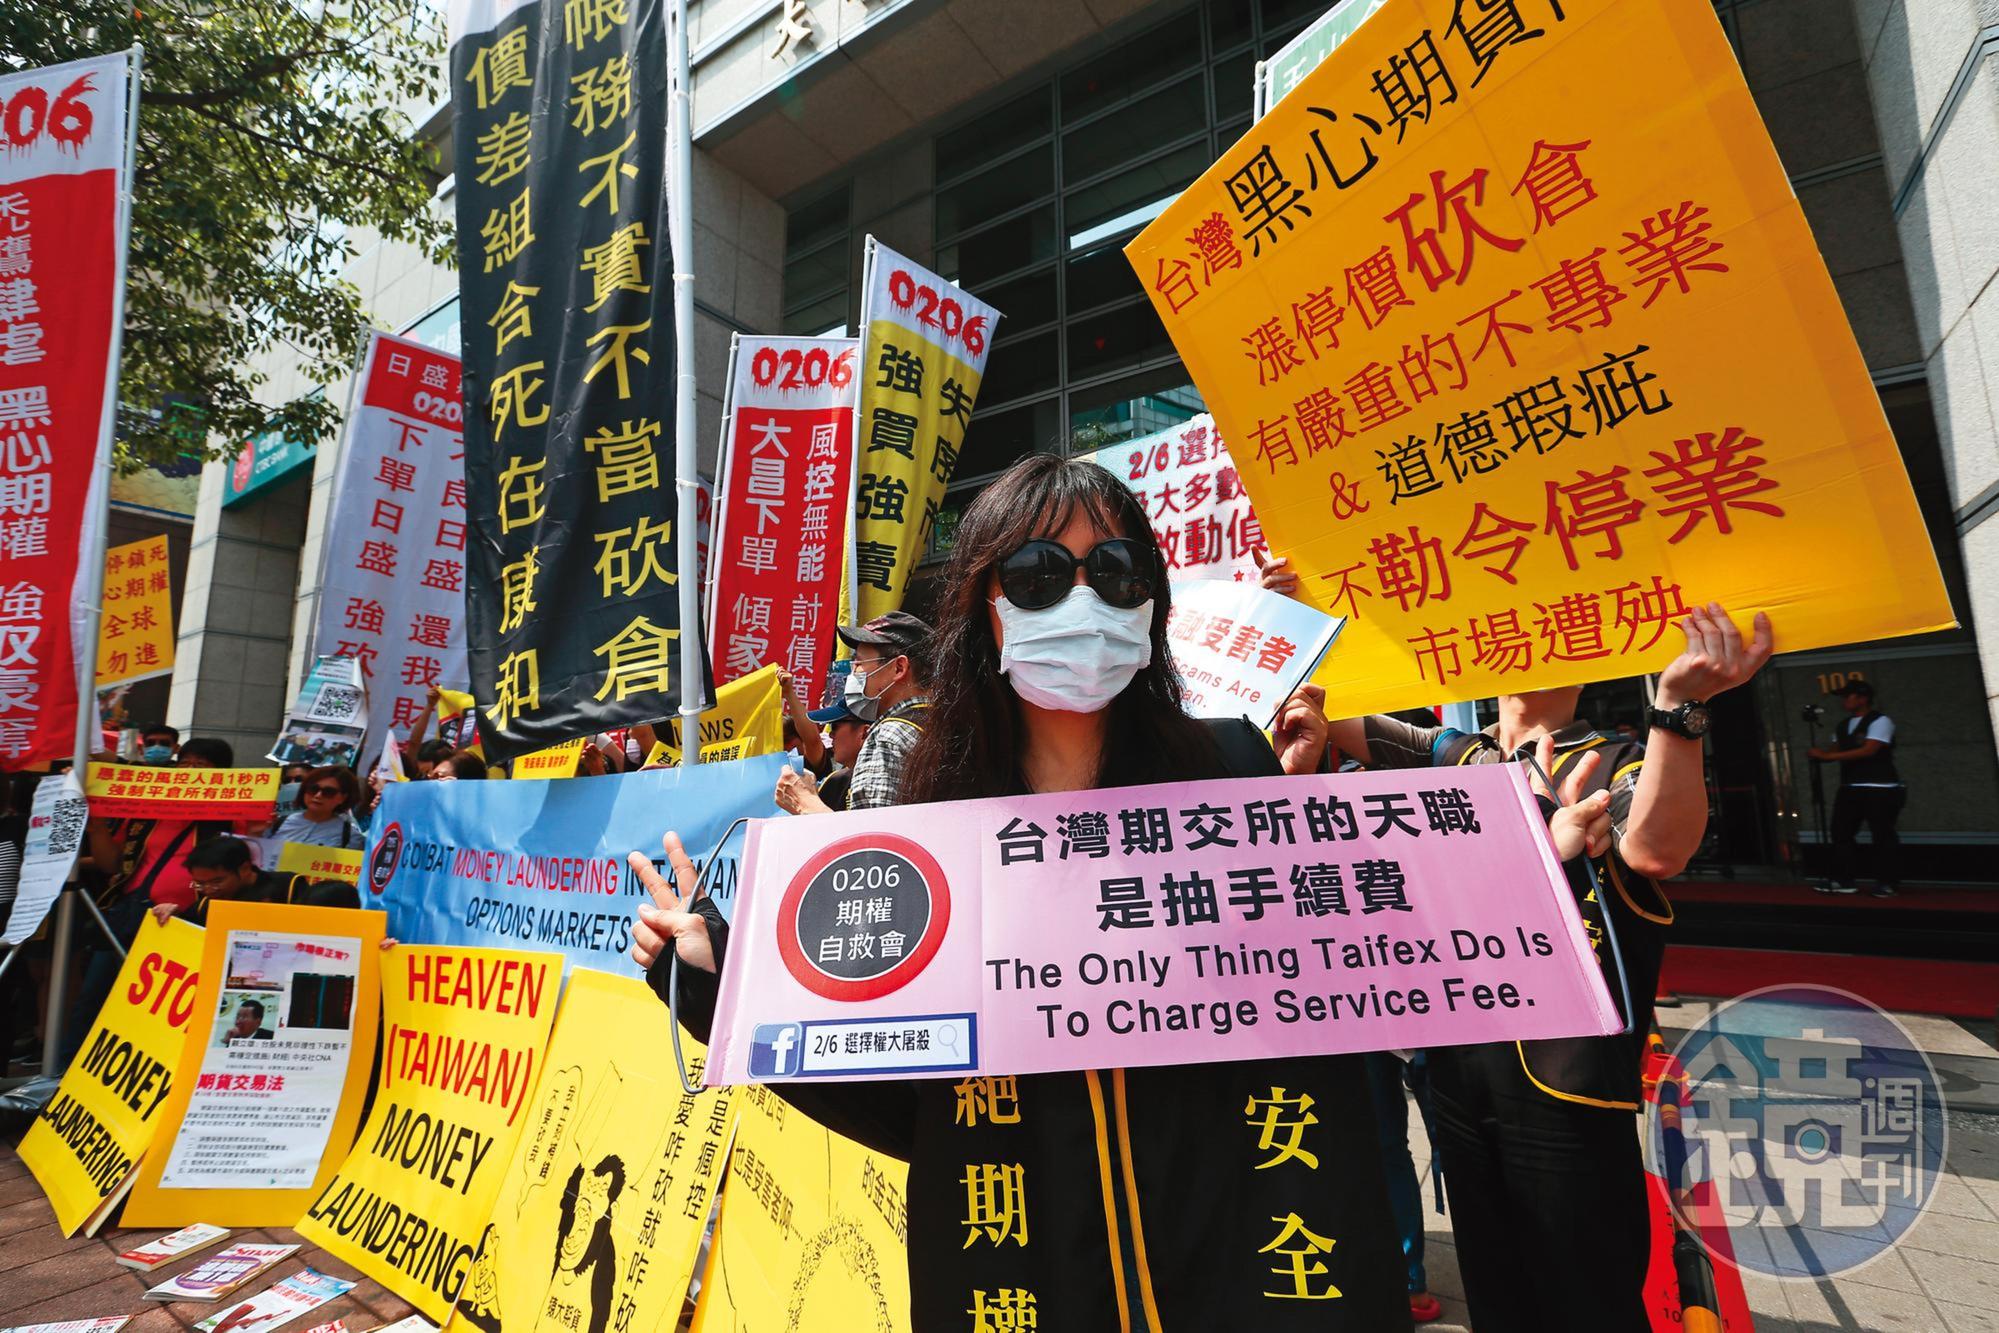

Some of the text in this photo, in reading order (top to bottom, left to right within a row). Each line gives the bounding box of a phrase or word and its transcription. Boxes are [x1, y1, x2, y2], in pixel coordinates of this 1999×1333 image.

[0, 72, 98, 160] 06
[1154, 0, 1566, 316] 台灣黑心期貨
[1242, 139, 1599, 386] 漲停價砍倉
[888, 270, 989, 360] 0206
[1247, 200, 1729, 475] 有嚴重的不專業
[388, 352, 463, 395] 日盛
[413, 391, 463, 424] 020
[751, 346, 856, 398] 0206
[857, 343, 925, 592] 強買強賣
[1129, 442, 1170, 480] 2/6
[1330, 344, 1672, 520] & 道德瑕疵
[355, 417, 428, 578] 下單日盛
[796, 422, 839, 583] 風控無能
[1321, 427, 1785, 621] 不勒令停業
[724, 417, 791, 682] 大昌下單 傾家
[96, 642, 160, 677] 勿進
[104, 605, 158, 639] 全球
[1407, 575, 1695, 686] 市場遭殃
[1227, 680, 1262, 703] Are
[995, 788, 1481, 867] 台灣期交所的天職
[452, 847, 505, 882] MONEY
[507, 854, 618, 896] LAUNDERING
[652, 858, 737, 899] TAWAN
[832, 864, 900, 892] 0206
[835, 897, 893, 928] 期權
[1095, 859, 1414, 933] 是抽手續費
[466, 896, 631, 953] OPTIONS MARKETS
[818, 929, 907, 964] 自救會
[986, 926, 1554, 991] The Only Thing Taifex Do Is
[128, 952, 198, 1033] STO
[408, 953, 547, 1018] HEAVEN
[1037, 978, 1535, 1038] To Charge Service Fee.
[80, 1028, 173, 1122] MONEY
[197, 1074, 285, 1091] 期貨交易法
[385, 1023, 534, 1127] (TAIWAN)
[814, 1029, 930, 1056] 2/6 選擇權大屠殺
[40, 1087, 131, 1199] LAUNDERING
[372, 1103, 494, 1195] MONEY
[1245, 1086, 1343, 1299] 安全
[308, 1175, 474, 1304] LAUNDERING
